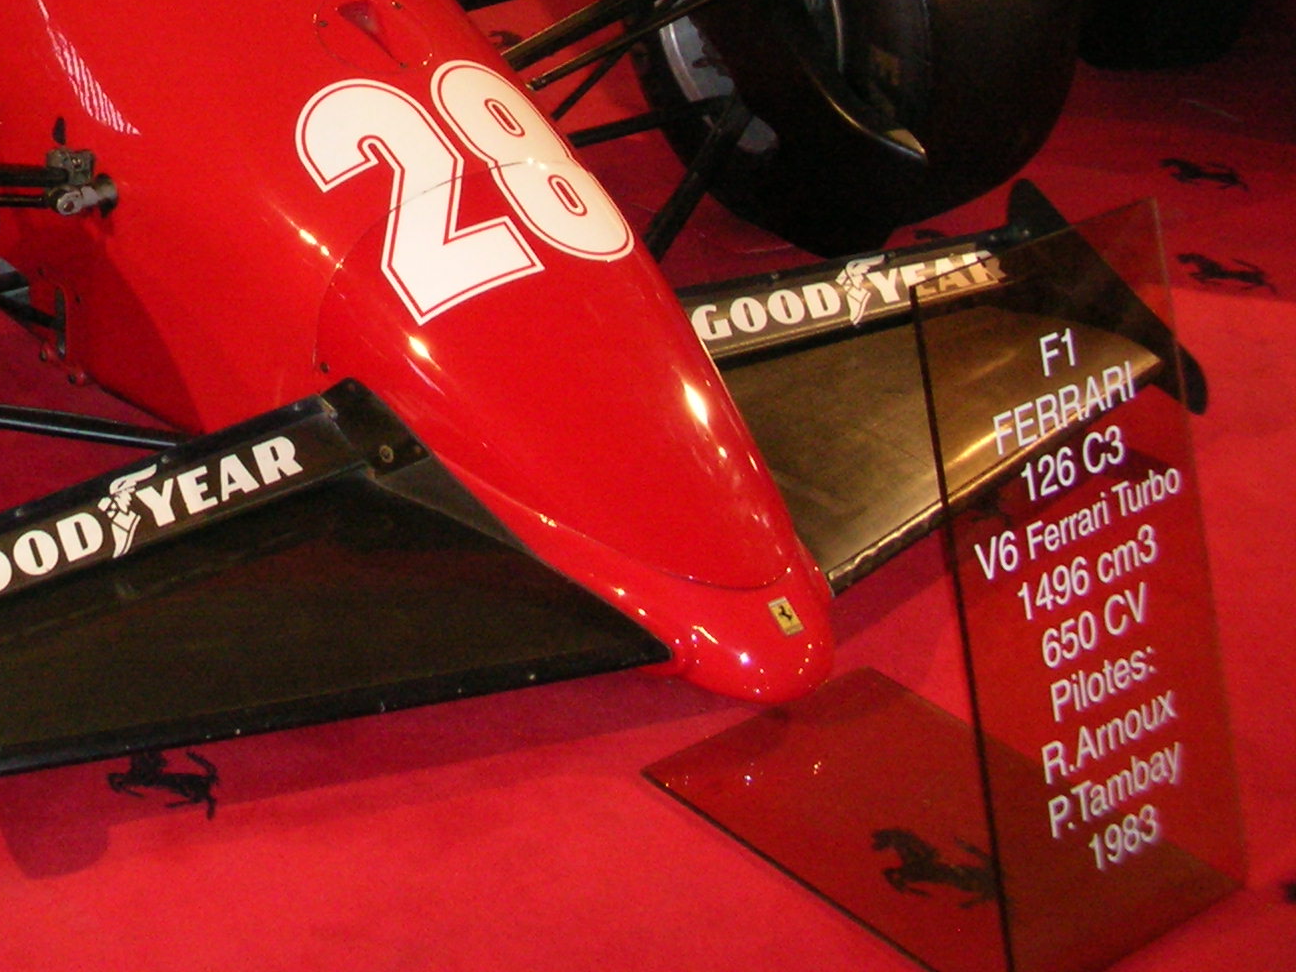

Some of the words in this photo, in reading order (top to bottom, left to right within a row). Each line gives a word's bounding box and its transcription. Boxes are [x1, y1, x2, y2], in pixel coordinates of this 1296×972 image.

[295, 59, 635, 326] 28
[1039, 328, 1076, 377] F1
[993, 361, 1136, 455] FERRARI
[1021, 446, 1076, 502] 126
[1082, 425, 1125, 474] C3
[974, 530, 1019, 580] V6
[1026, 491, 1111, 560] Ferrari
[1111, 468, 1181, 517] Turbo
[1017, 556, 1090, 621] 1496
[1097, 524, 1158, 583] cm3
[1041, 610, 1097, 668] 650
[1104, 581, 1147, 636] CV
[1050, 645, 1155, 722] Pilotes:
[1041, 689, 1176, 785] R.Arnoux
[1047, 741, 1182, 839] P.Tambay
[1088, 804, 1158, 871] 1983
